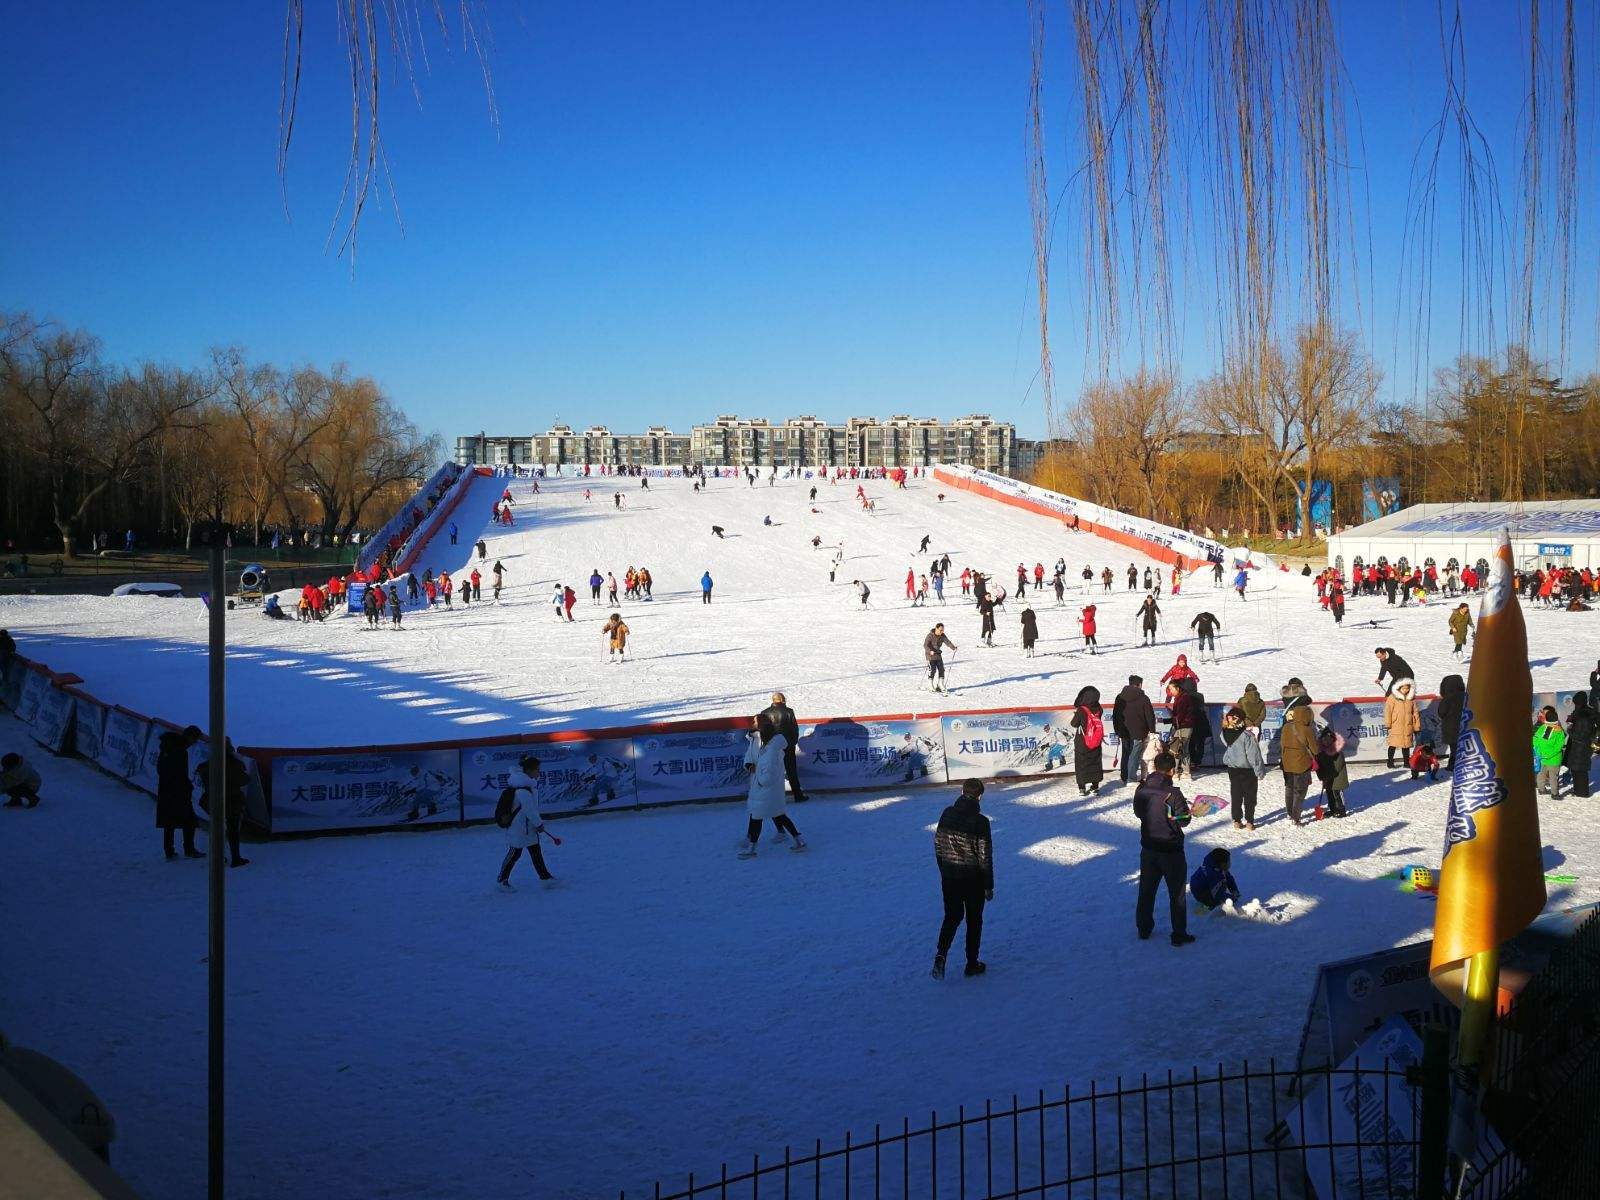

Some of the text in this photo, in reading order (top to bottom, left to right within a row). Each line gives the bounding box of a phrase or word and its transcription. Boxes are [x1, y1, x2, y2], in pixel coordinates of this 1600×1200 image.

[812, 746, 898, 764] 大雪山滑雪场
[958, 736, 1038, 755] 大雪山滑雪场
[652, 754, 745, 777] 大雪山滑雪场
[481, 769, 581, 791] 大雪滑雪场
[291, 781, 400, 802] 大雪山滑雪场
